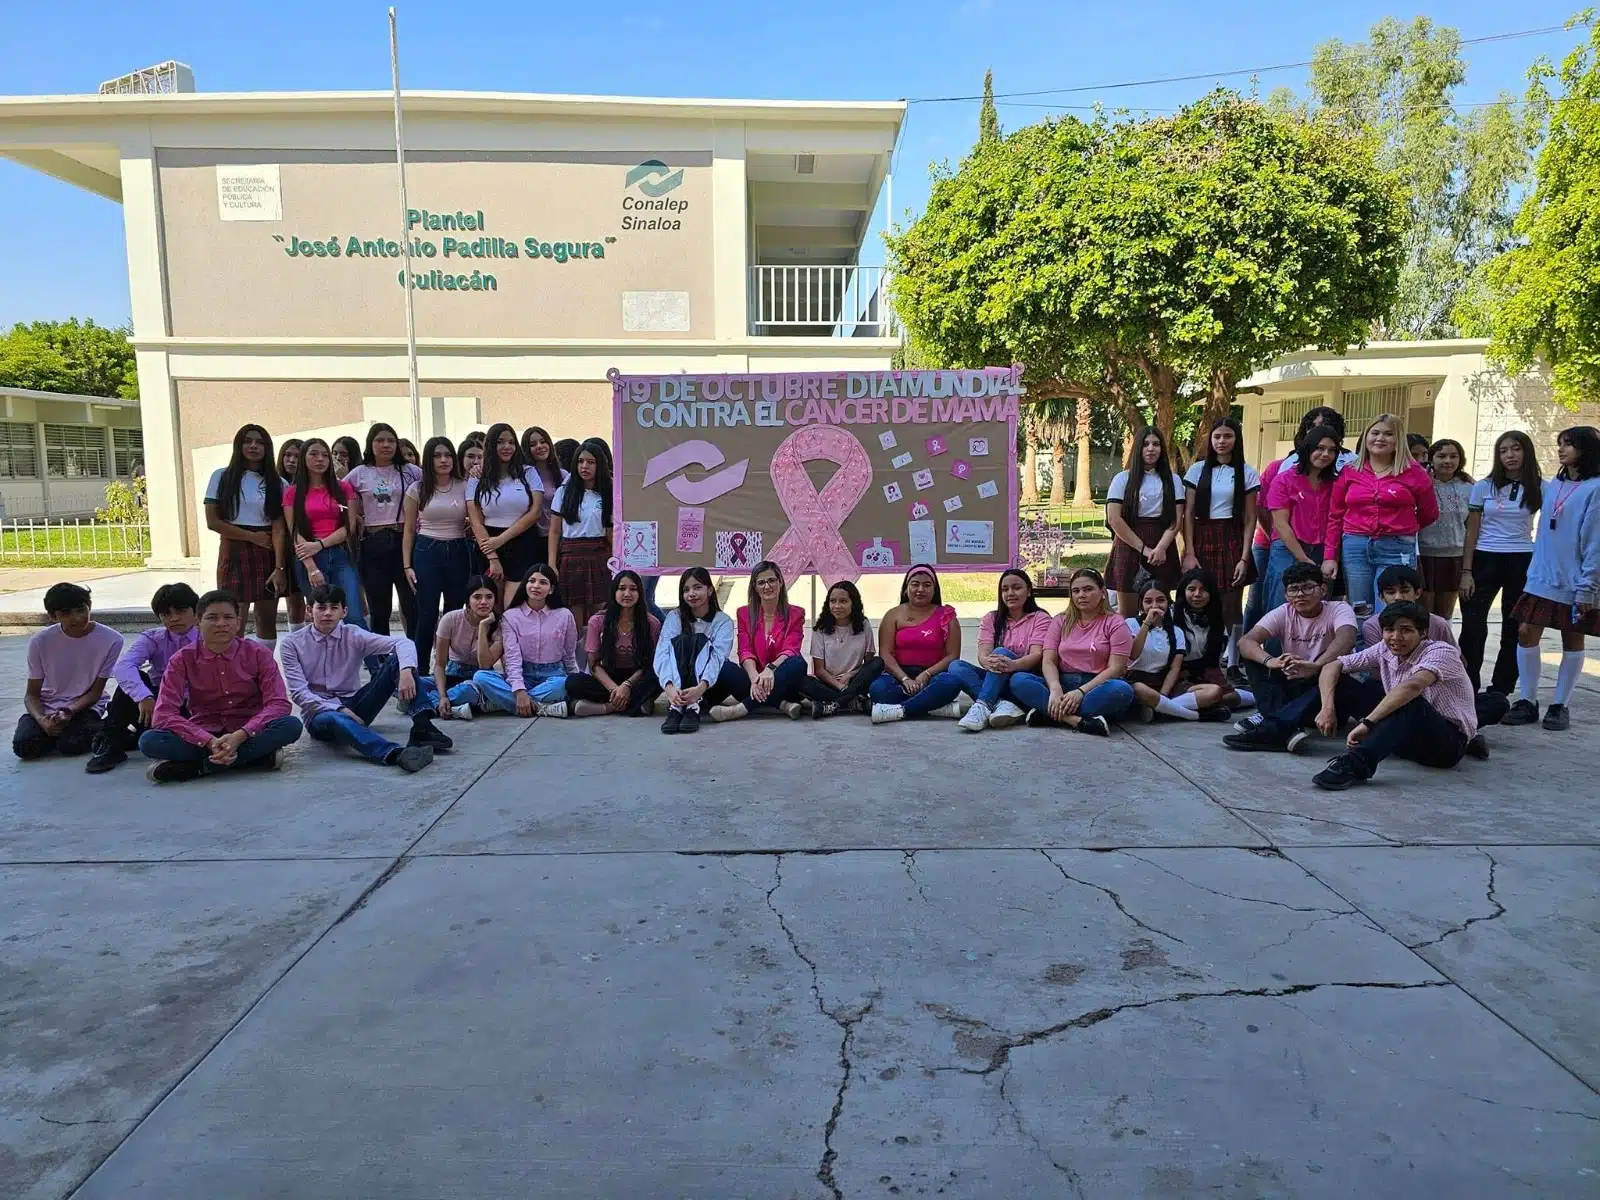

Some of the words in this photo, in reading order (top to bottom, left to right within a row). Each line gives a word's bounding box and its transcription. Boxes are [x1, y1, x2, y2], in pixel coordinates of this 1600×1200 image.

[622, 196, 688, 214] Conalep
[407, 209, 485, 231] Plantel
[621, 215, 681, 230] Sinaloa
[443, 237, 519, 259] Padilla
[398, 269, 498, 292] Culiacán
[623, 379, 652, 403] 19
[659, 376, 697, 402] DE
[701, 374, 838, 402] OCTUBRE
[636, 401, 752, 428] CONTRA
[754, 401, 785, 427] EL
[784, 399, 889, 426] CANCER
[891, 399, 928, 424] DE
[931, 394, 1018, 424] MAMA
